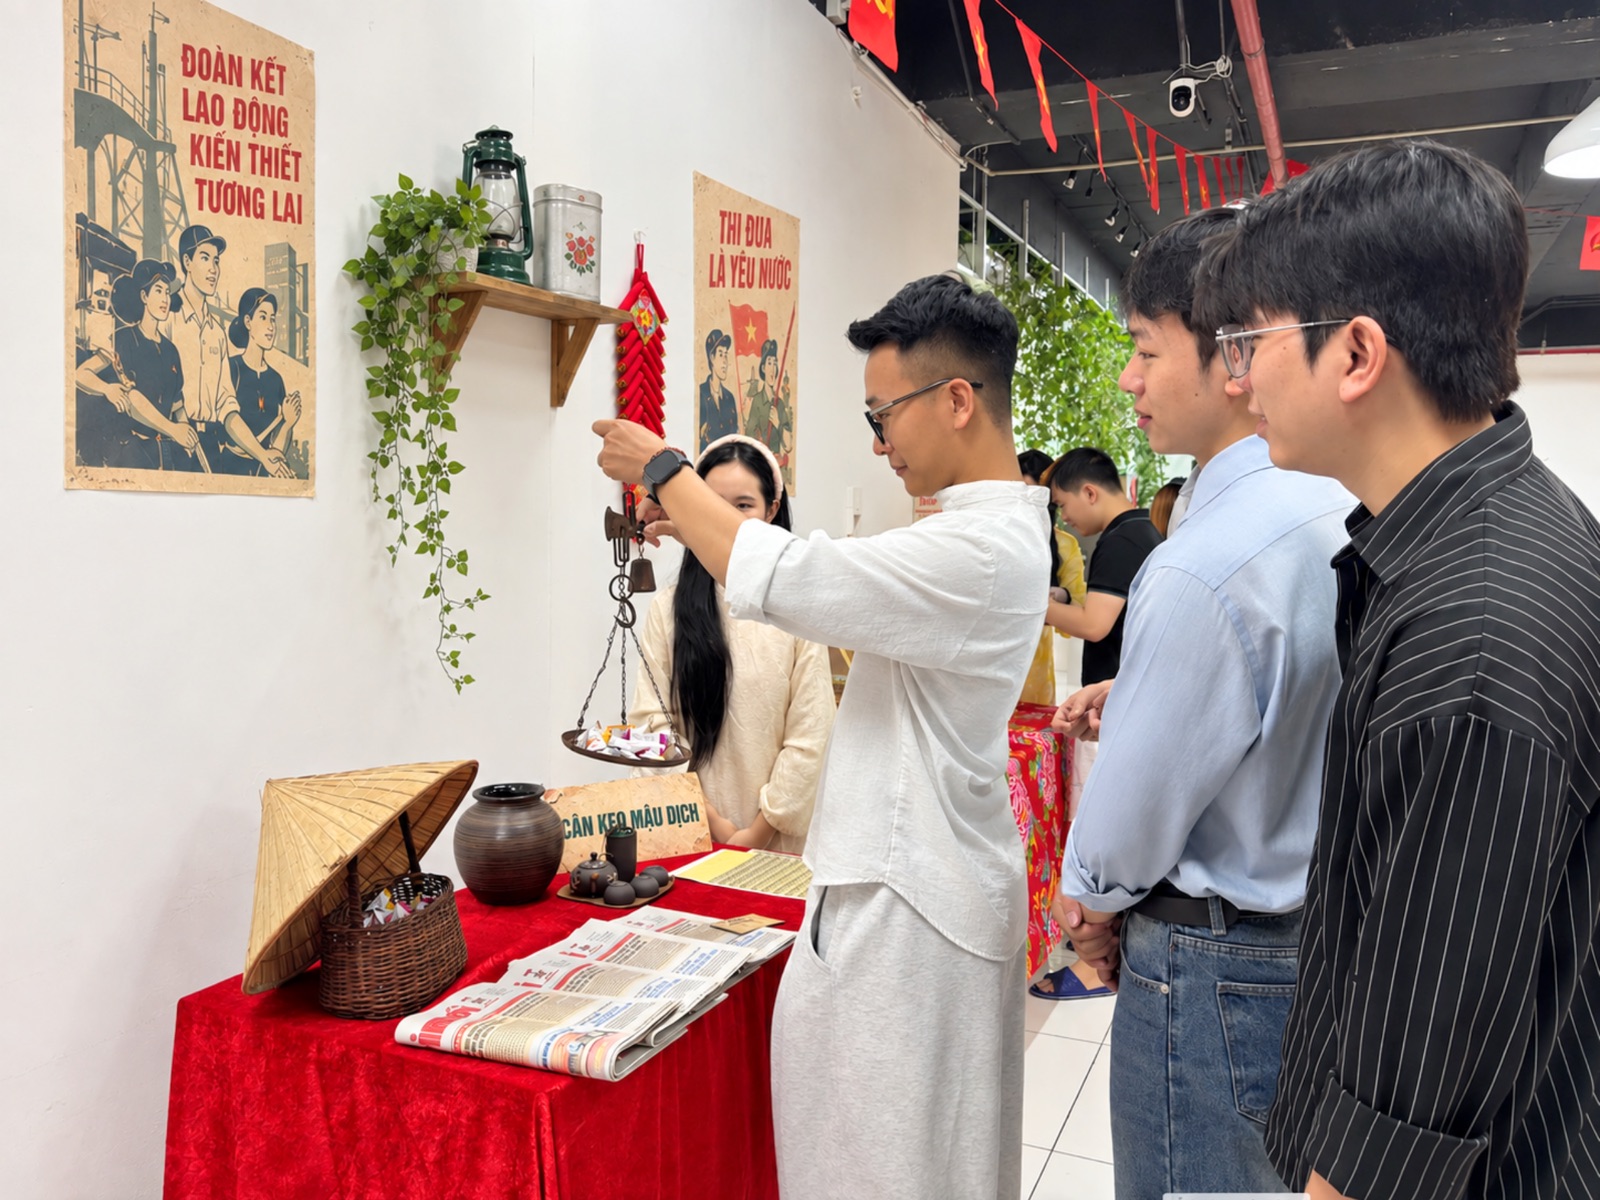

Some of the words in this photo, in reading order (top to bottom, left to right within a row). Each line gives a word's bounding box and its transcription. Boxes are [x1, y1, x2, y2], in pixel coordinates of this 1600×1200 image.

[181, 43, 243, 88] ĐOÀN
[250, 55, 287, 96] KẾT
[182, 87, 225, 127] LAO
[232, 96, 289, 138] ĐỘNG
[190, 130, 241, 173] KIẾN
[248, 142, 302, 183] THIẾT
[194, 177, 265, 220] TƯƠNG
[272, 190, 303, 225] LAI
[719, 209, 742, 246] THI
[745, 213, 772, 249] ĐUA
[708, 247, 726, 288] LÀ
[730, 249, 755, 289] YÊU
[758, 254, 792, 290] NƯỚC
[562, 813, 594, 839] CÂN
[630, 803, 664, 832] MẬU
[666, 802, 700, 828] DỊCH
